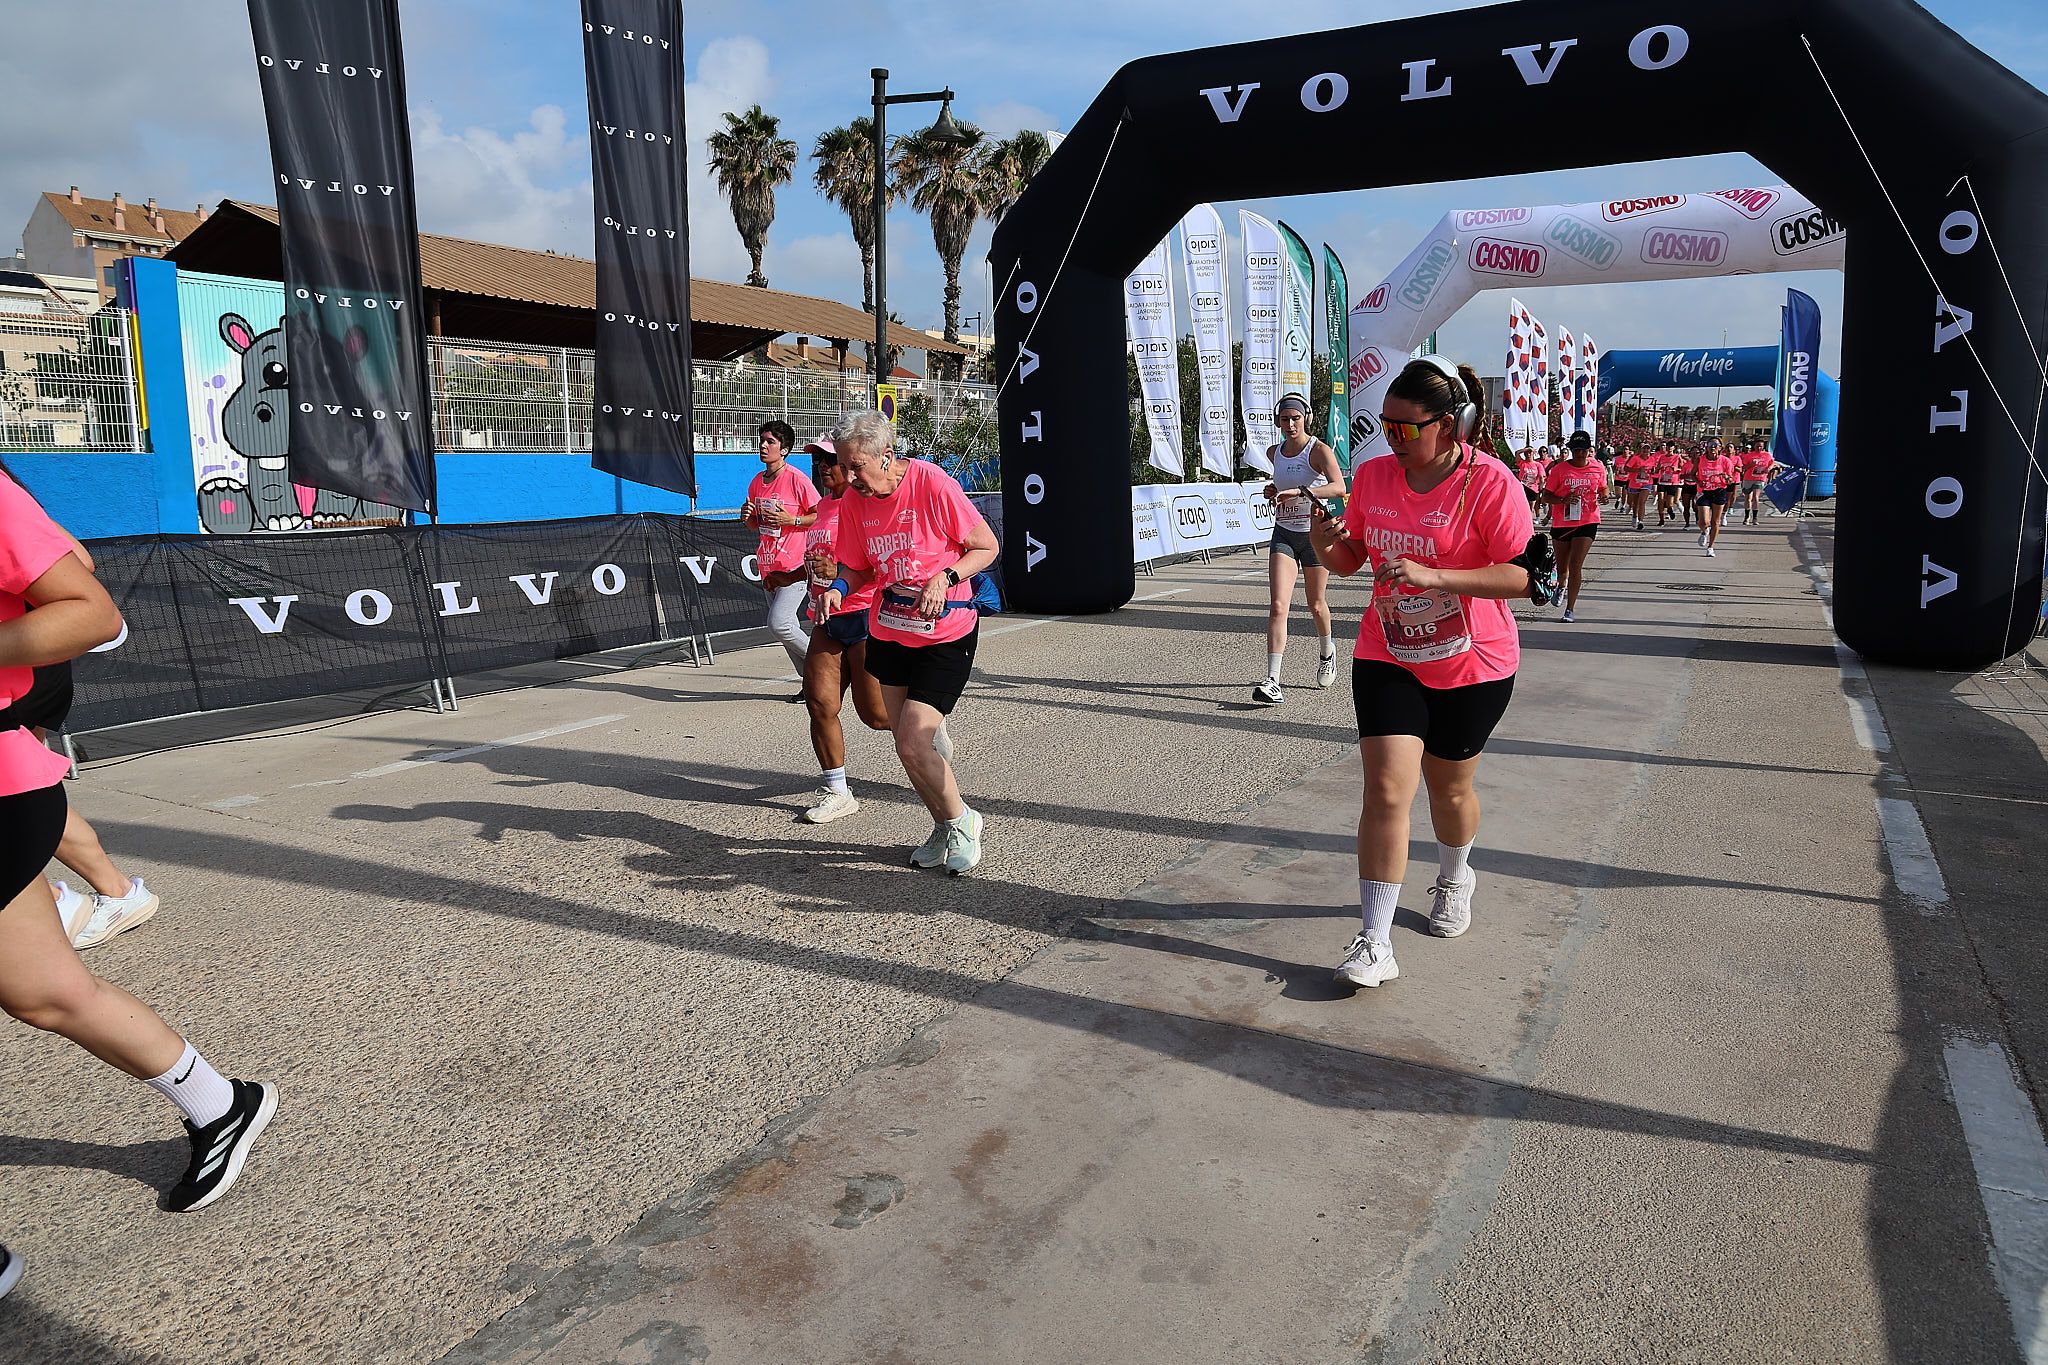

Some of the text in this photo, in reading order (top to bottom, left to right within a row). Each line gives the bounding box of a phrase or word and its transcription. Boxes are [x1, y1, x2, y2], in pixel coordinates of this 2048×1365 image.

[1200, 24, 1689, 123] VOLVO
[1462, 207, 1527, 227] COSMO
[1608, 195, 1679, 217] COSMO
[1549, 221, 1615, 265] COSMO
[1649, 232, 1721, 263] COSMO
[1475, 244, 1541, 275] COSMO
[1402, 245, 1452, 306] COSMO
[1658, 352, 1734, 382] Marlene
[1920, 210, 1979, 610] VOLVO
[1017, 279, 1047, 574] VOLVO
[1177, 506, 1206, 531] ziaja
[1368, 506, 1398, 518] OYSHO
[1365, 526, 1438, 560] CARRERA
[229, 564, 626, 633] VOLVO
[1404, 622, 1438, 638] 016
